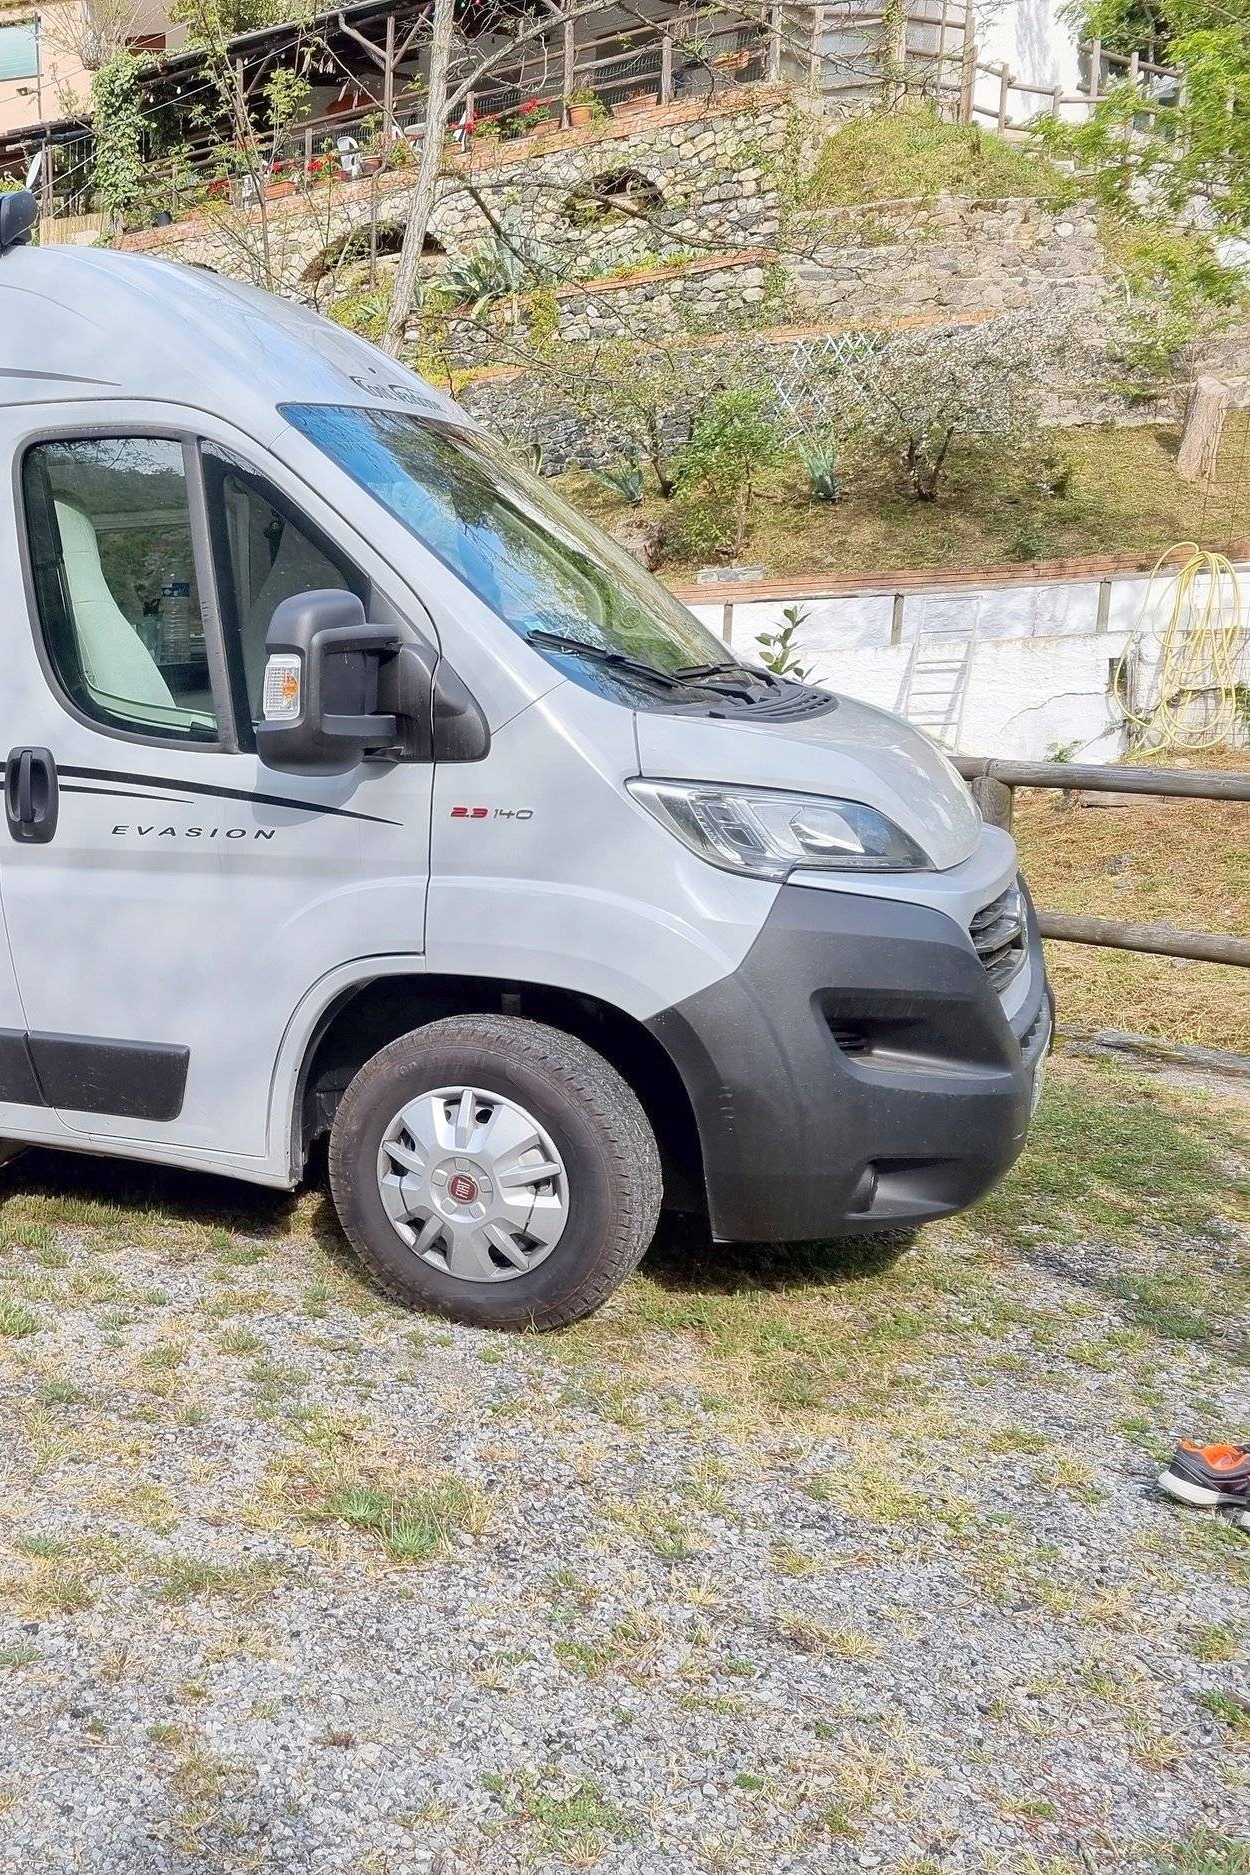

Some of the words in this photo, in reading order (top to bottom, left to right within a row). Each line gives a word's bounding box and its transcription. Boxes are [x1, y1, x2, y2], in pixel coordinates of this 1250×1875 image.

[493, 808, 534, 820] 140
[111, 825, 276, 840] EVASION
[455, 1179, 471, 1199] FIAT
